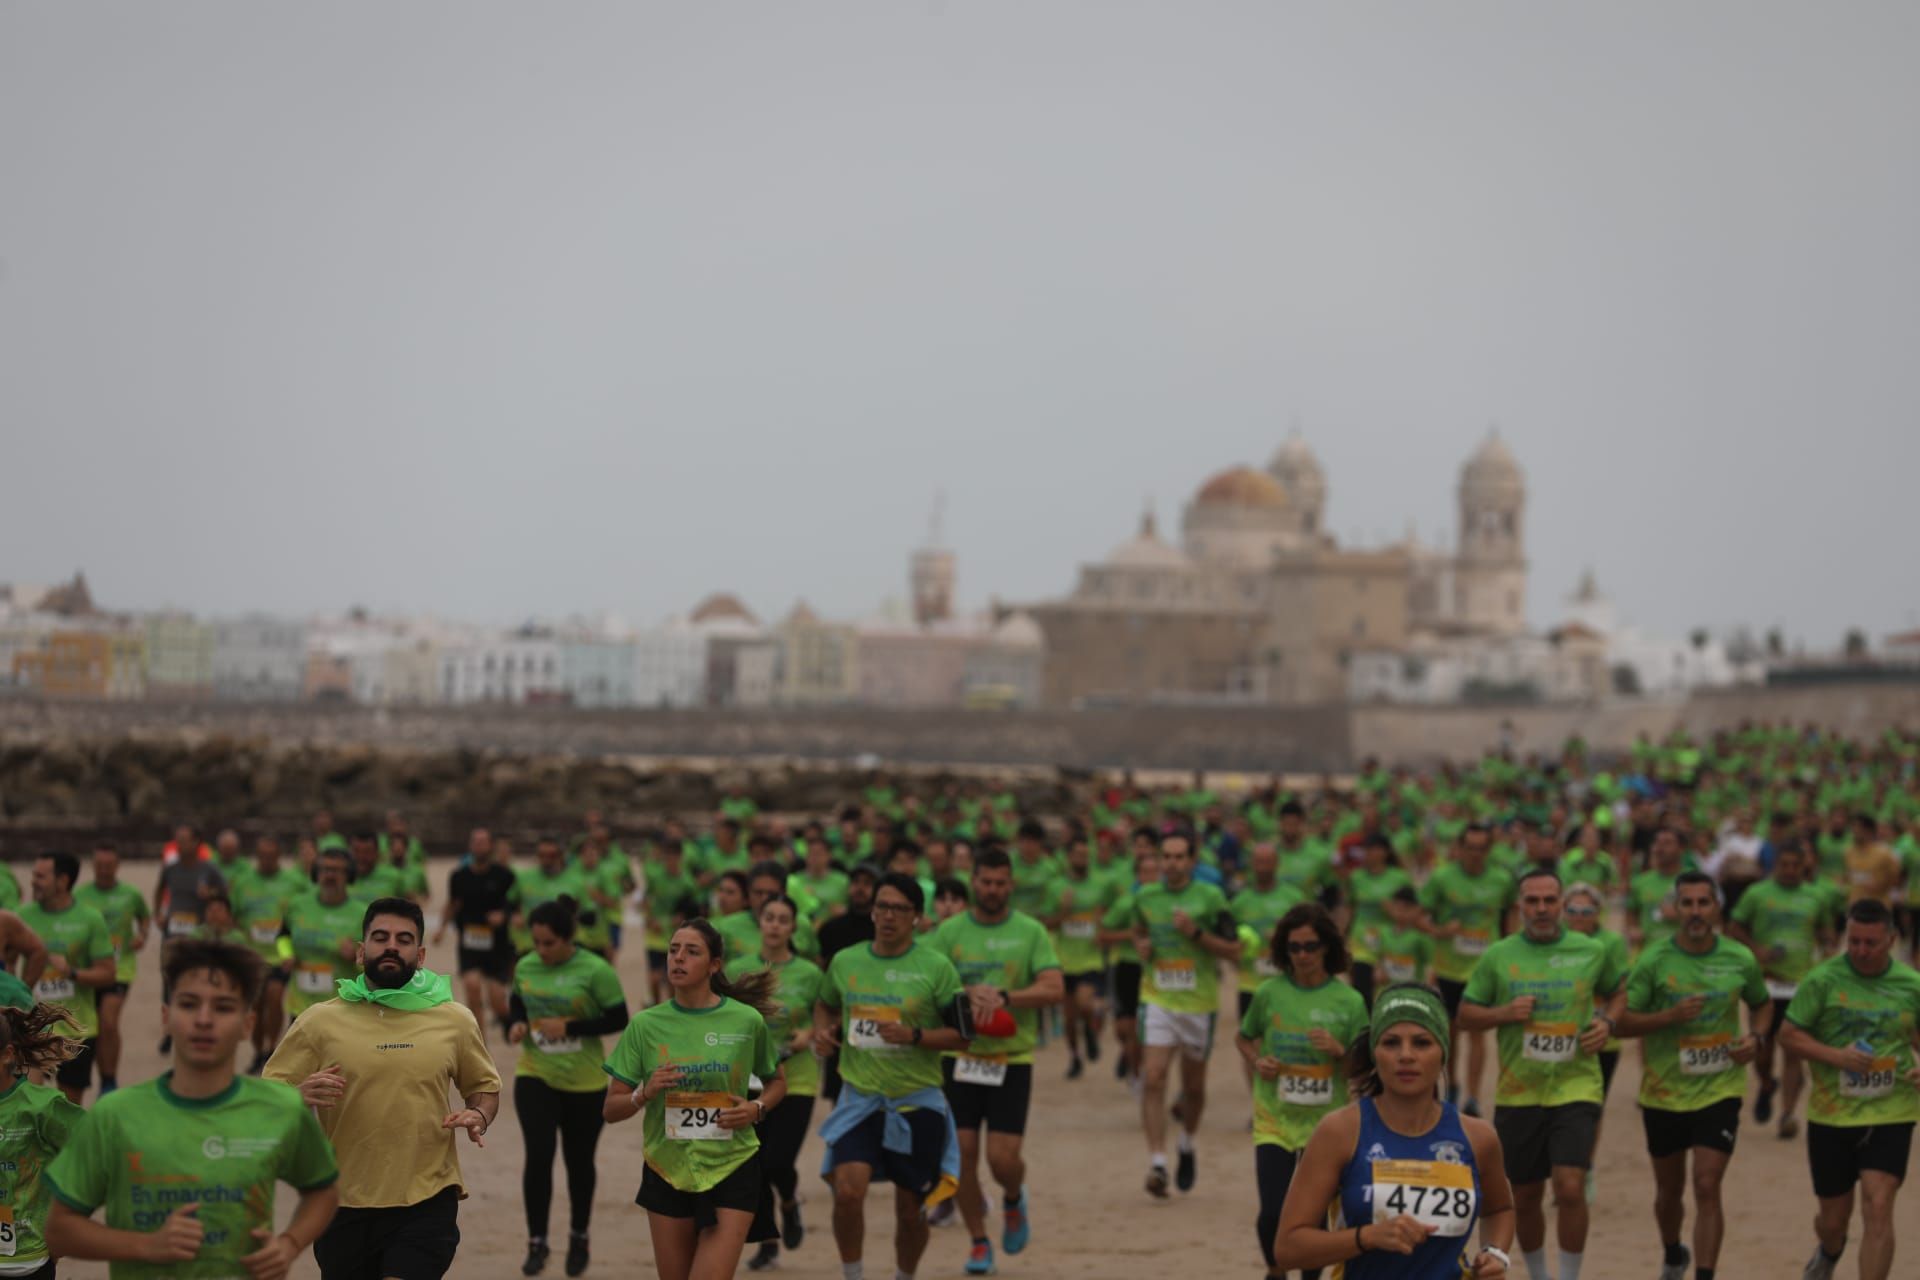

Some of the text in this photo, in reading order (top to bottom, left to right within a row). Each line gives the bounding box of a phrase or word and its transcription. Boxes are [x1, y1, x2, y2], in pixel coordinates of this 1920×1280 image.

[1530, 1034, 1574, 1052] 4287
[1686, 1046, 1729, 1065] 3999
[677, 1061, 729, 1073] marcha
[1285, 1077, 1329, 1095] 3544
[158, 1184, 244, 1202] marcha
[1386, 1184, 1470, 1218] 4728
